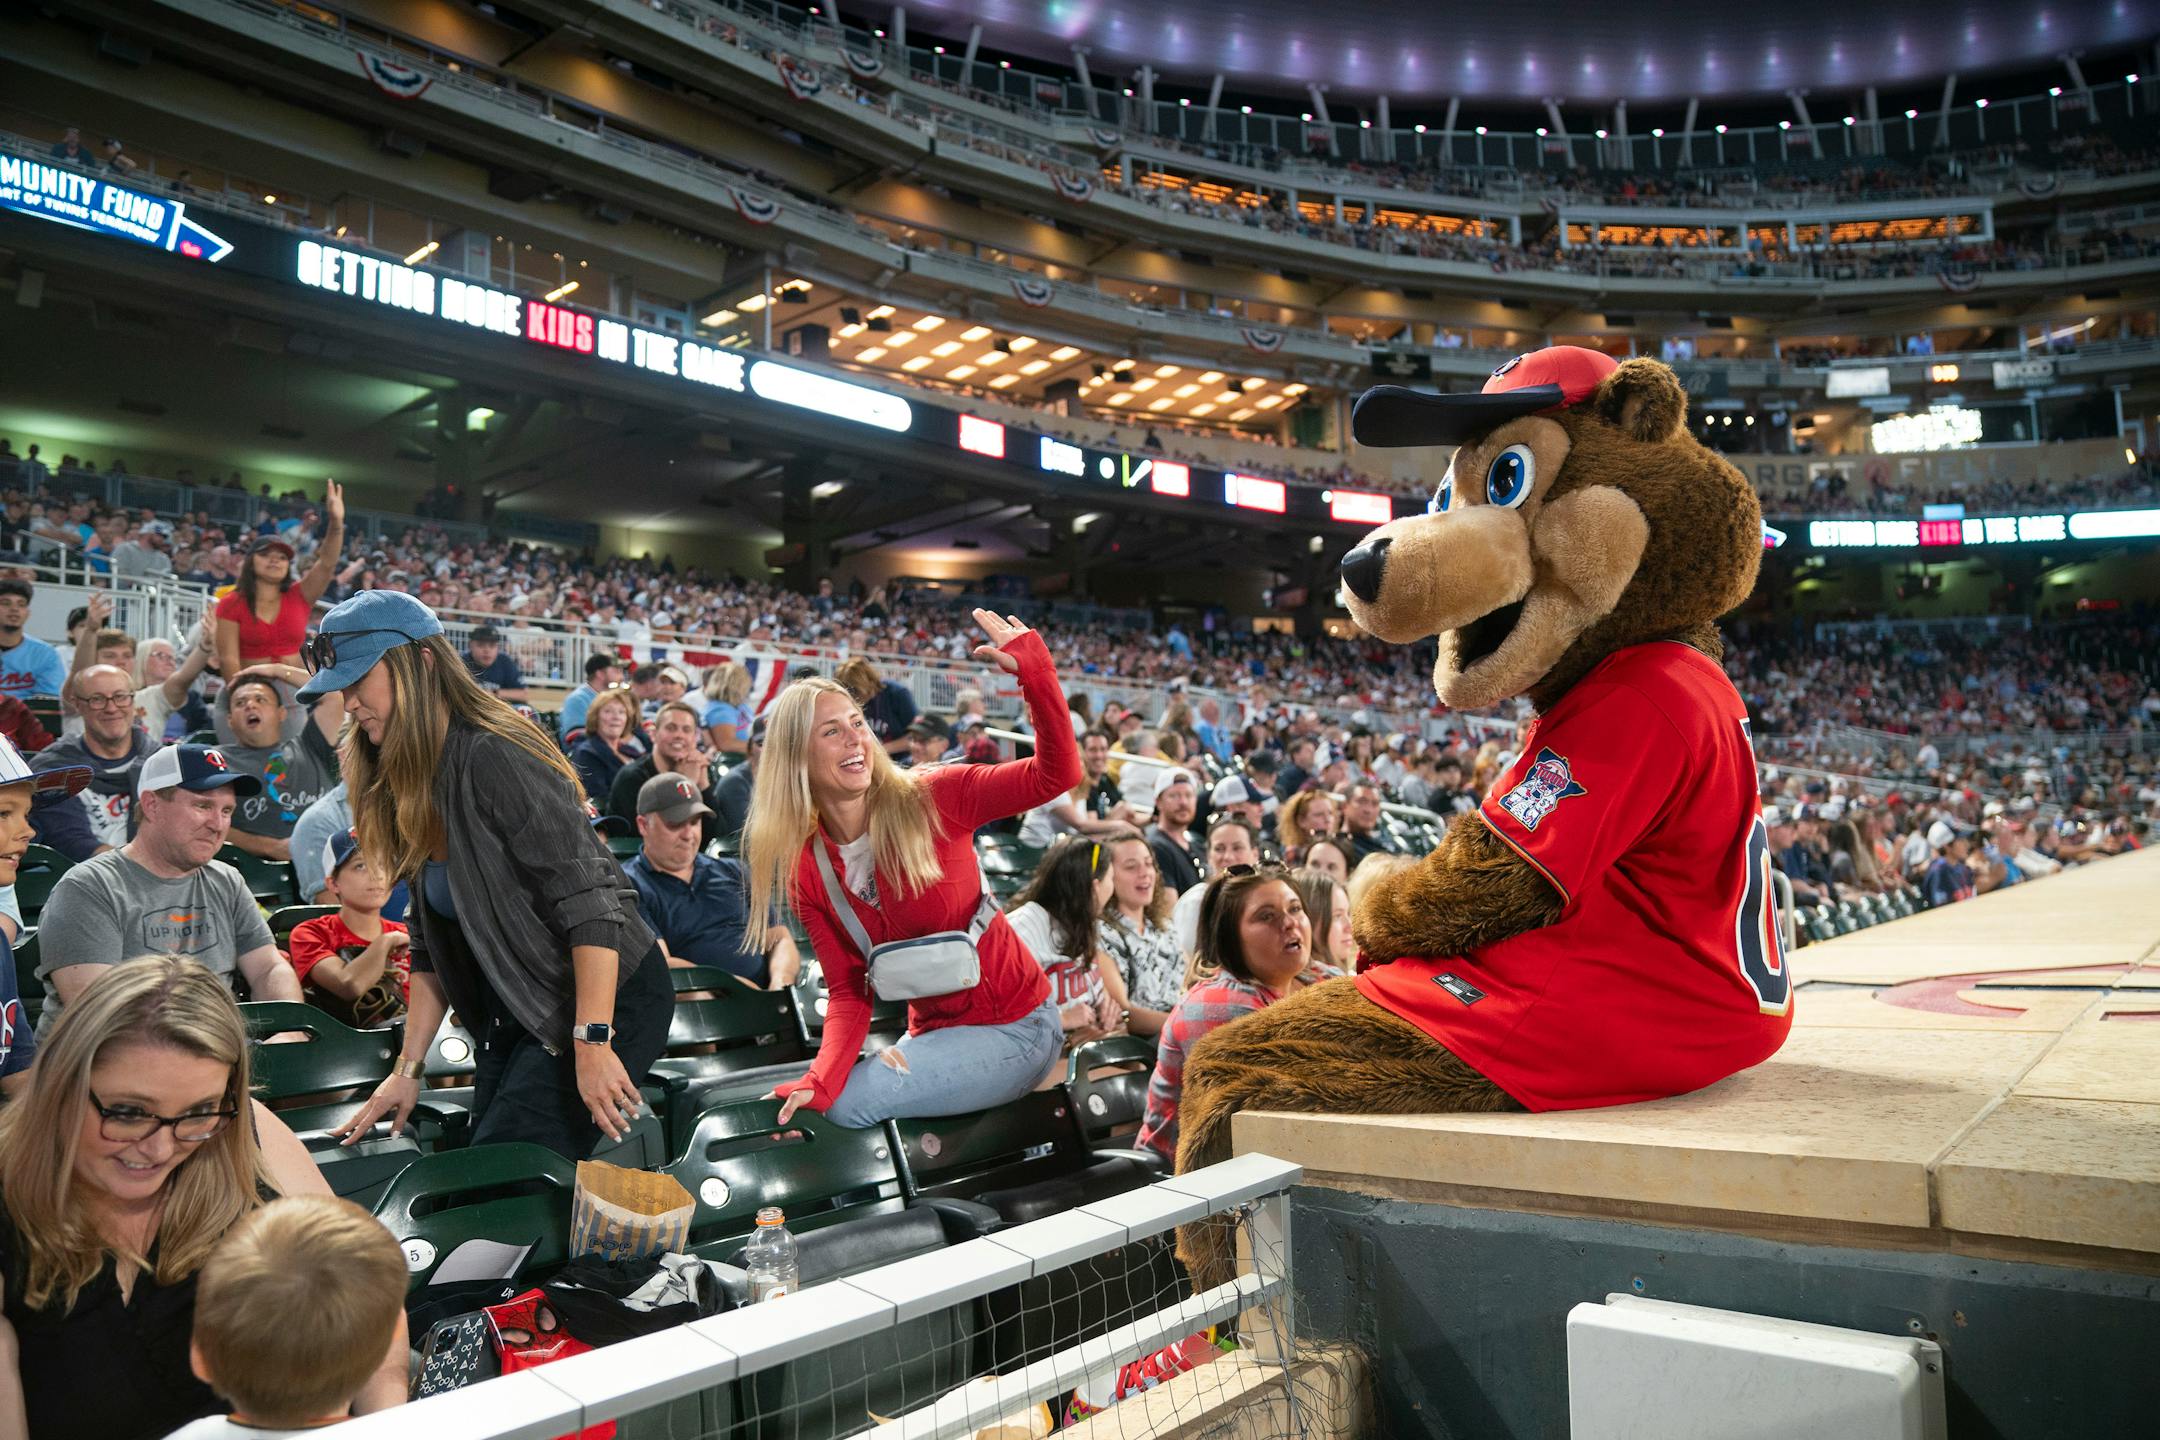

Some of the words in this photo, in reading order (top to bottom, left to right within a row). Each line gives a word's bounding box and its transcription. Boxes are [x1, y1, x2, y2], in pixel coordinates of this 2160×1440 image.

[44, 197, 90, 220] TWINS
[102, 185, 166, 231] FUND
[297, 240, 435, 315] GETTING
[526, 300, 594, 354] KIDS
[151, 927, 170, 938] UP
[410, 1249, 420, 1262] 5
